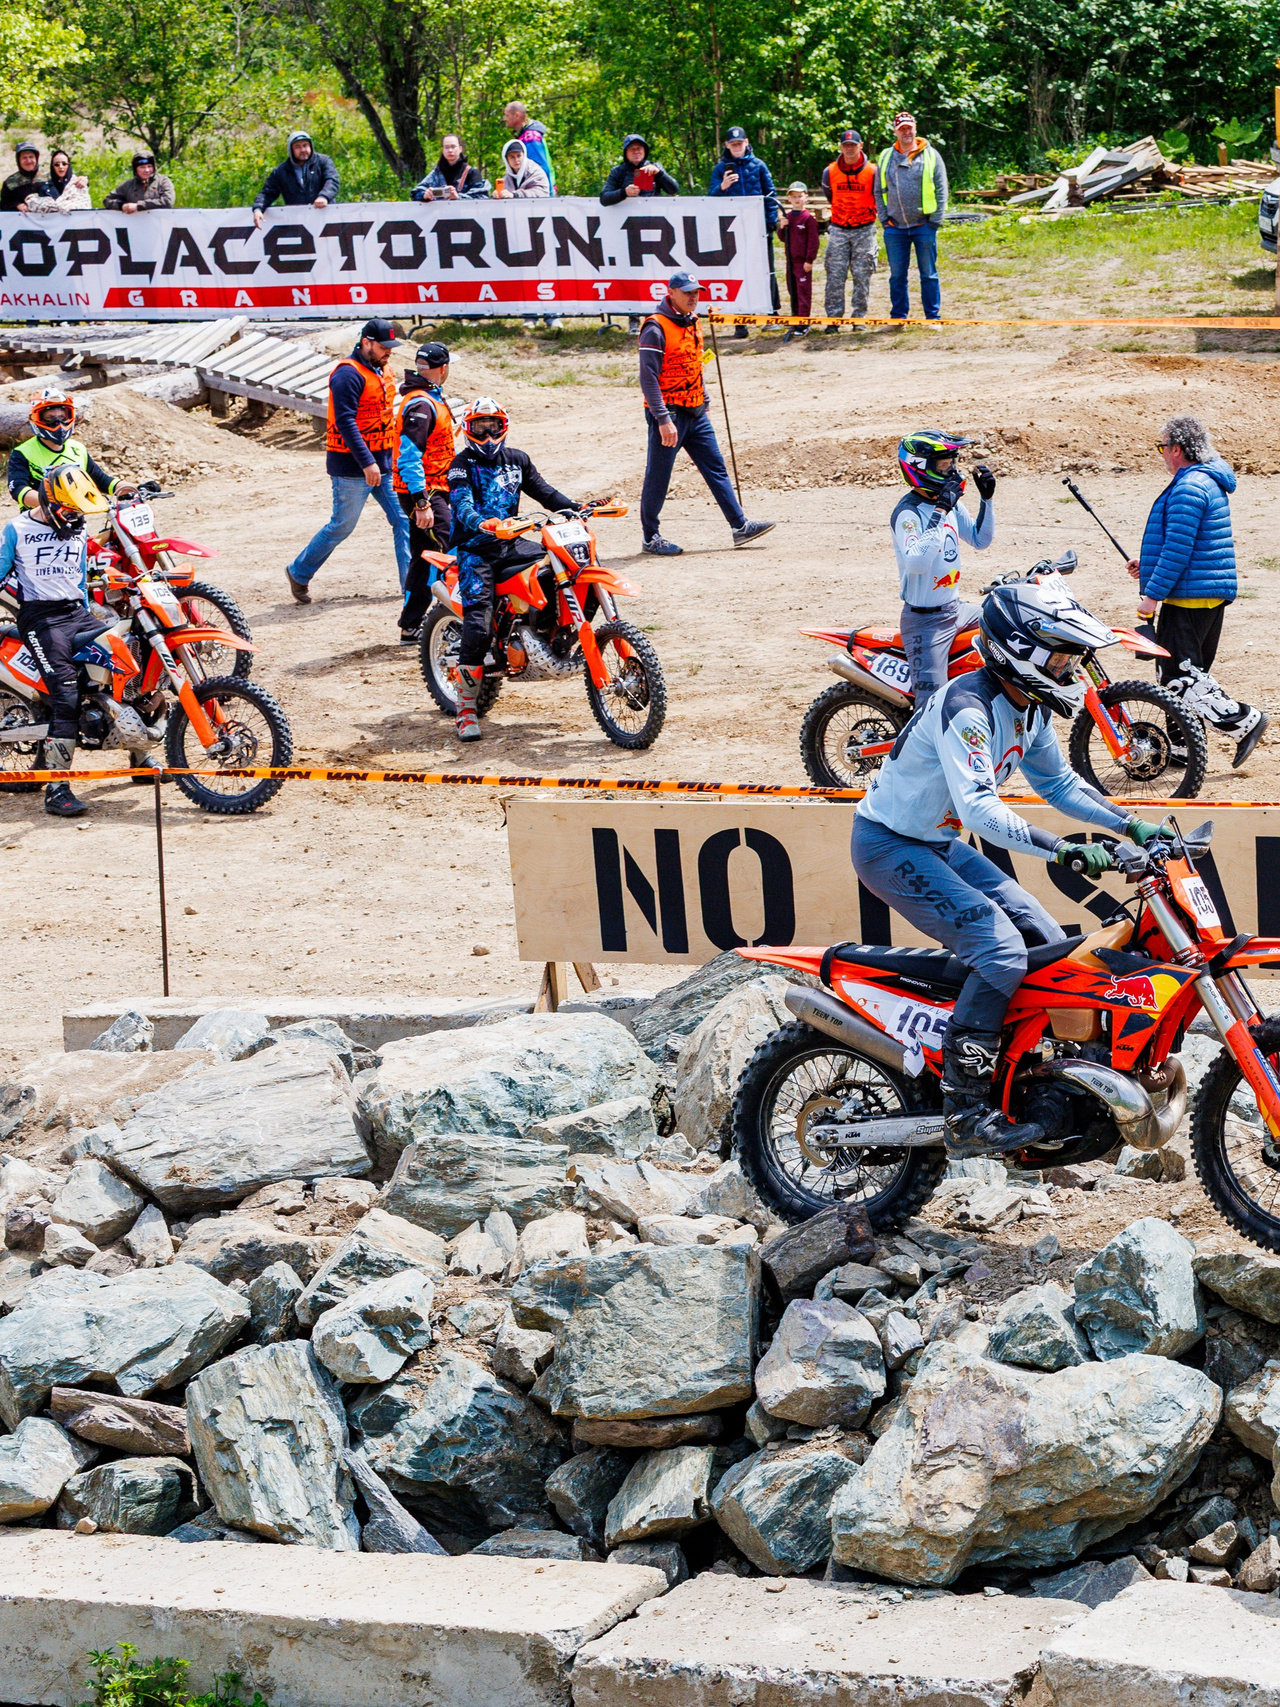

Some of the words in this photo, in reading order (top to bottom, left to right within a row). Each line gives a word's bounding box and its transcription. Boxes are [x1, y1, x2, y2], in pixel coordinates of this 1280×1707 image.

[0, 214, 738, 284] OPLACETORUN.RU
[733, 317, 757, 325] KTM
[766, 317, 789, 325] KTM
[87, 552, 112, 571] AS
[27, 630, 55, 674] FASTHOUSE
[988, 640, 1006, 664] SHOEI
[591, 826, 796, 954] NO
[954, 903, 994, 930] KTM
[812, 1007, 830, 1022] TEEN
[829, 1015, 844, 1027] TOP
[914, 1002, 950, 1020] SILVE
[1115, 1044, 1134, 1052] KTM
[1244, 1055, 1266, 1092] FACTORY
[1090, 1077, 1103, 1090] TEEN
[1102, 1085, 1114, 1095] TOP
[845, 1131, 861, 1139] KTM
